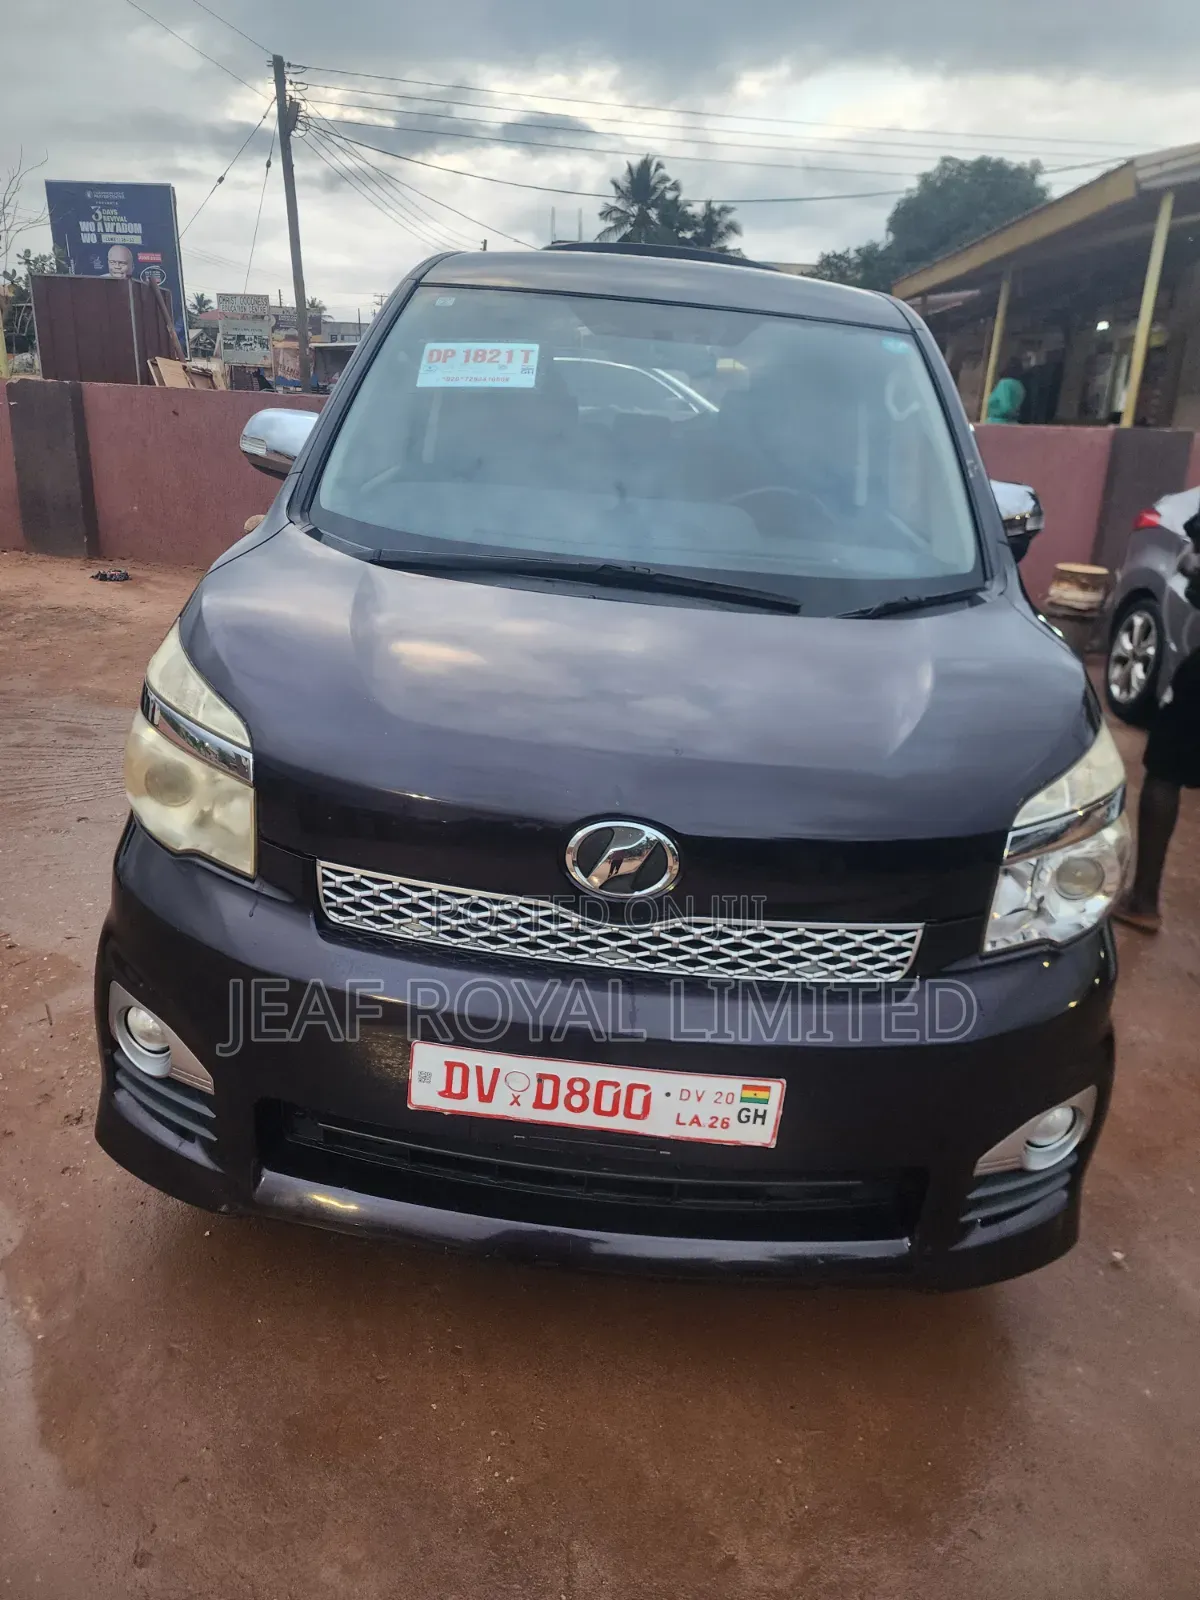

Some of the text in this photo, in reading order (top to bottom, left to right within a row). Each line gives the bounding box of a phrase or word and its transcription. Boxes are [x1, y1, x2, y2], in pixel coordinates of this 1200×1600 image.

[91, 206, 102, 221] 3
[79, 221, 95, 232] WO
[97, 222, 103, 232] A
[80, 232, 97, 243] WO
[218, 295, 237, 305] CHRIST
[221, 304, 246, 312] EDUCATION
[427, 348, 456, 364] DP
[462, 348, 514, 364] 1821
[437, 1060, 651, 1121] DV D800
[679, 1088, 735, 1104] DV 20
[737, 1107, 767, 1125] GH
